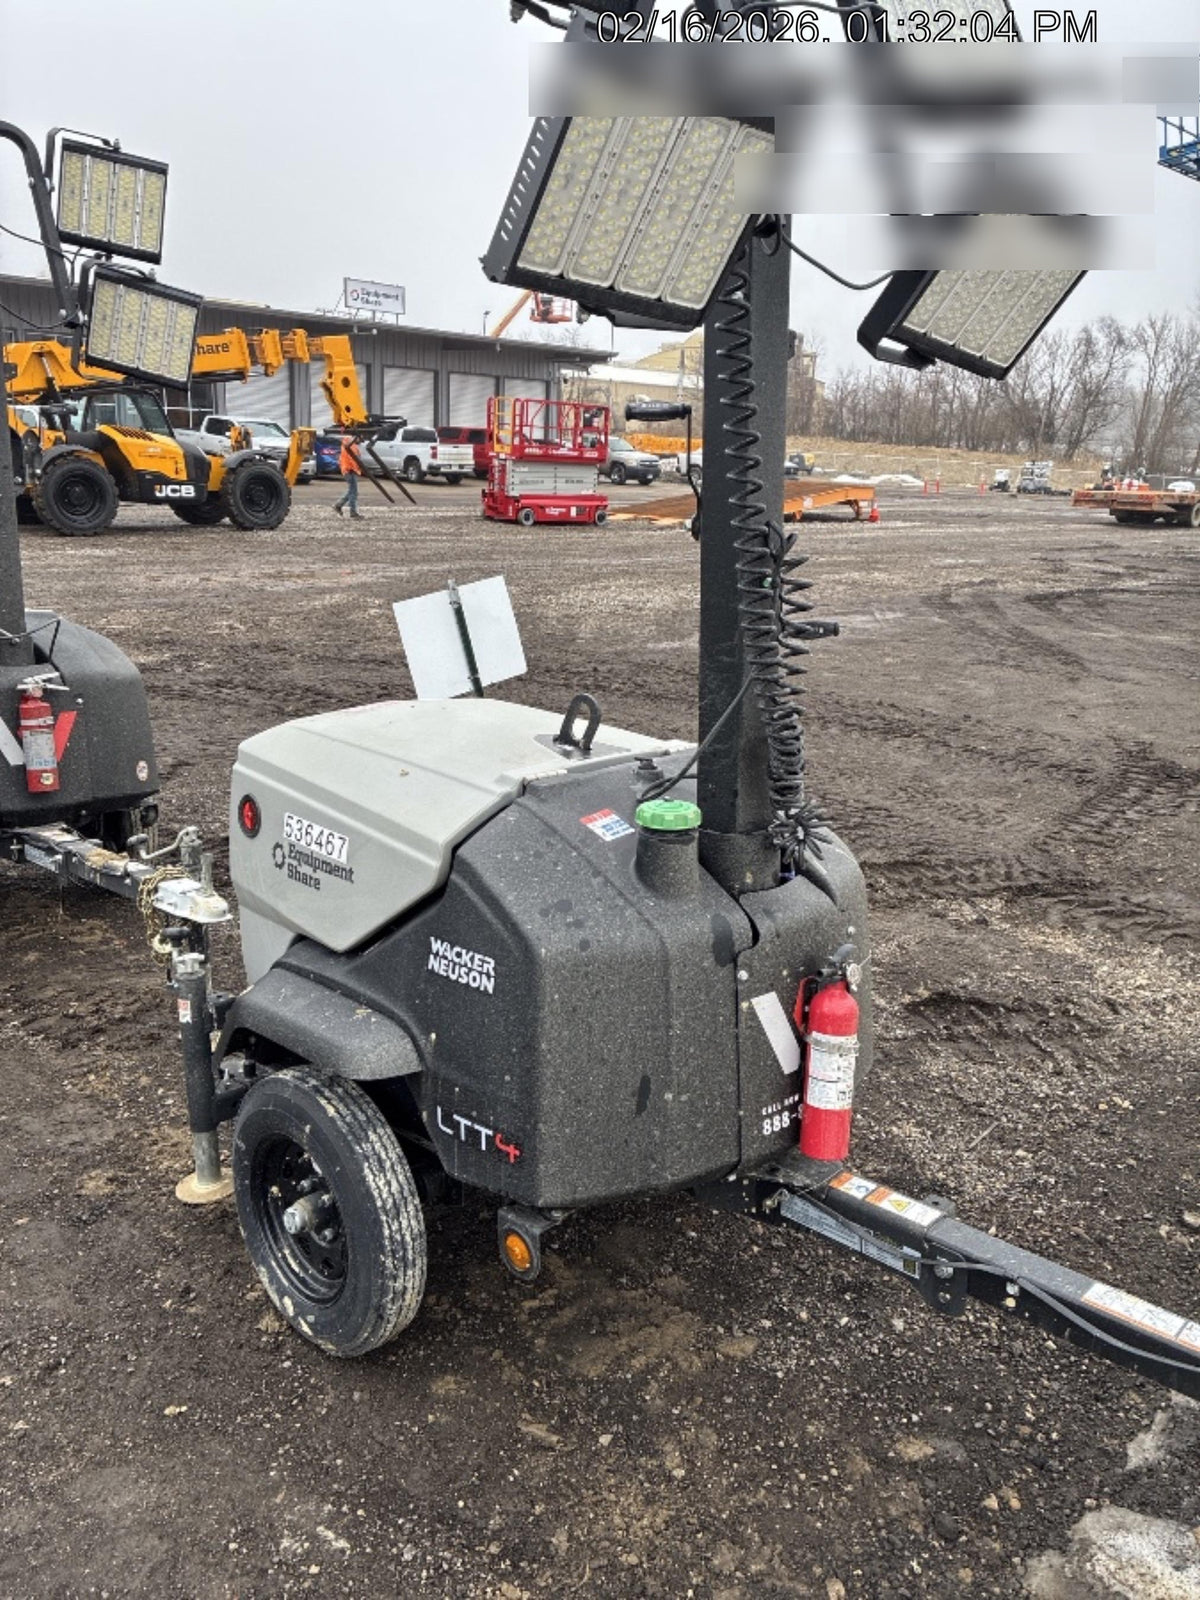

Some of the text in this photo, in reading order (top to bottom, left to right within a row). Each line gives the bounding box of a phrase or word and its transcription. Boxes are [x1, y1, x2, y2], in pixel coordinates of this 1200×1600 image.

[196, 342, 230, 355] hare
[154, 484, 196, 497] JCB
[285, 815, 348, 859] 536467
[287, 842, 355, 884] Equipment
[287, 862, 321, 891] Share
[427, 954, 496, 994] NEUSON
[429, 936, 496, 976] WACKER
[436, 1105, 521, 1164] LTT4
